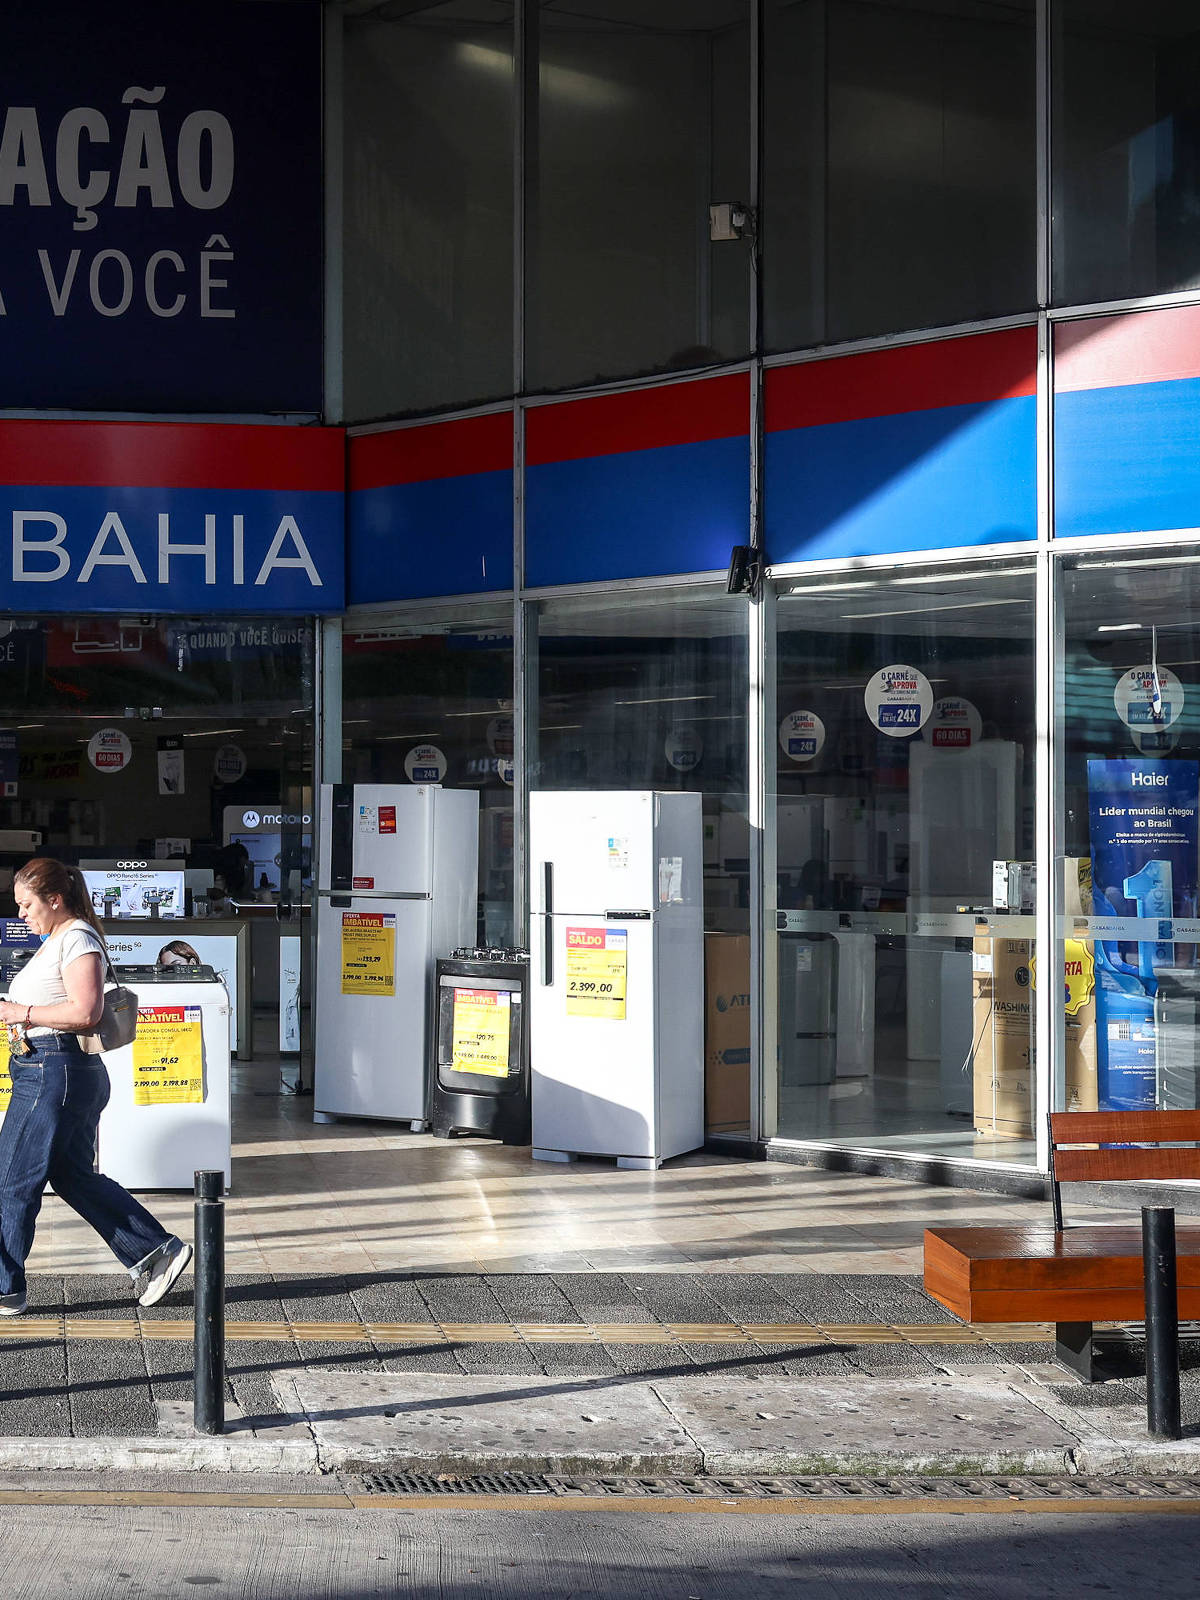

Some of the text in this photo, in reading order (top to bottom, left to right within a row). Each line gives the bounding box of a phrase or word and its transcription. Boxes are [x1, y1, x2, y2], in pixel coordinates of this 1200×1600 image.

[37, 234, 236, 318] VOCÊ
[190, 630, 237, 649] QUANDO
[887, 670, 909, 680] CARNÉ
[1137, 672, 1155, 680] CARN
[893, 681, 918, 689] APROVA
[897, 708, 917, 722] 24X
[1131, 772, 1169, 786] Haier
[1099, 806, 1194, 818] Líder mundial chegou
[1134, 818, 1172, 828] ao Brasil
[117, 861, 148, 870] oppo
[343, 917, 382, 927] IMBATÍVEL
[568, 935, 602, 945] SALDO
[1064, 960, 1083, 976] RTA
[569, 982, 613, 994] 2.399,00
[136, 1012, 183, 1023] MBATÍVEL
[160, 1057, 179, 1065] 91,62
